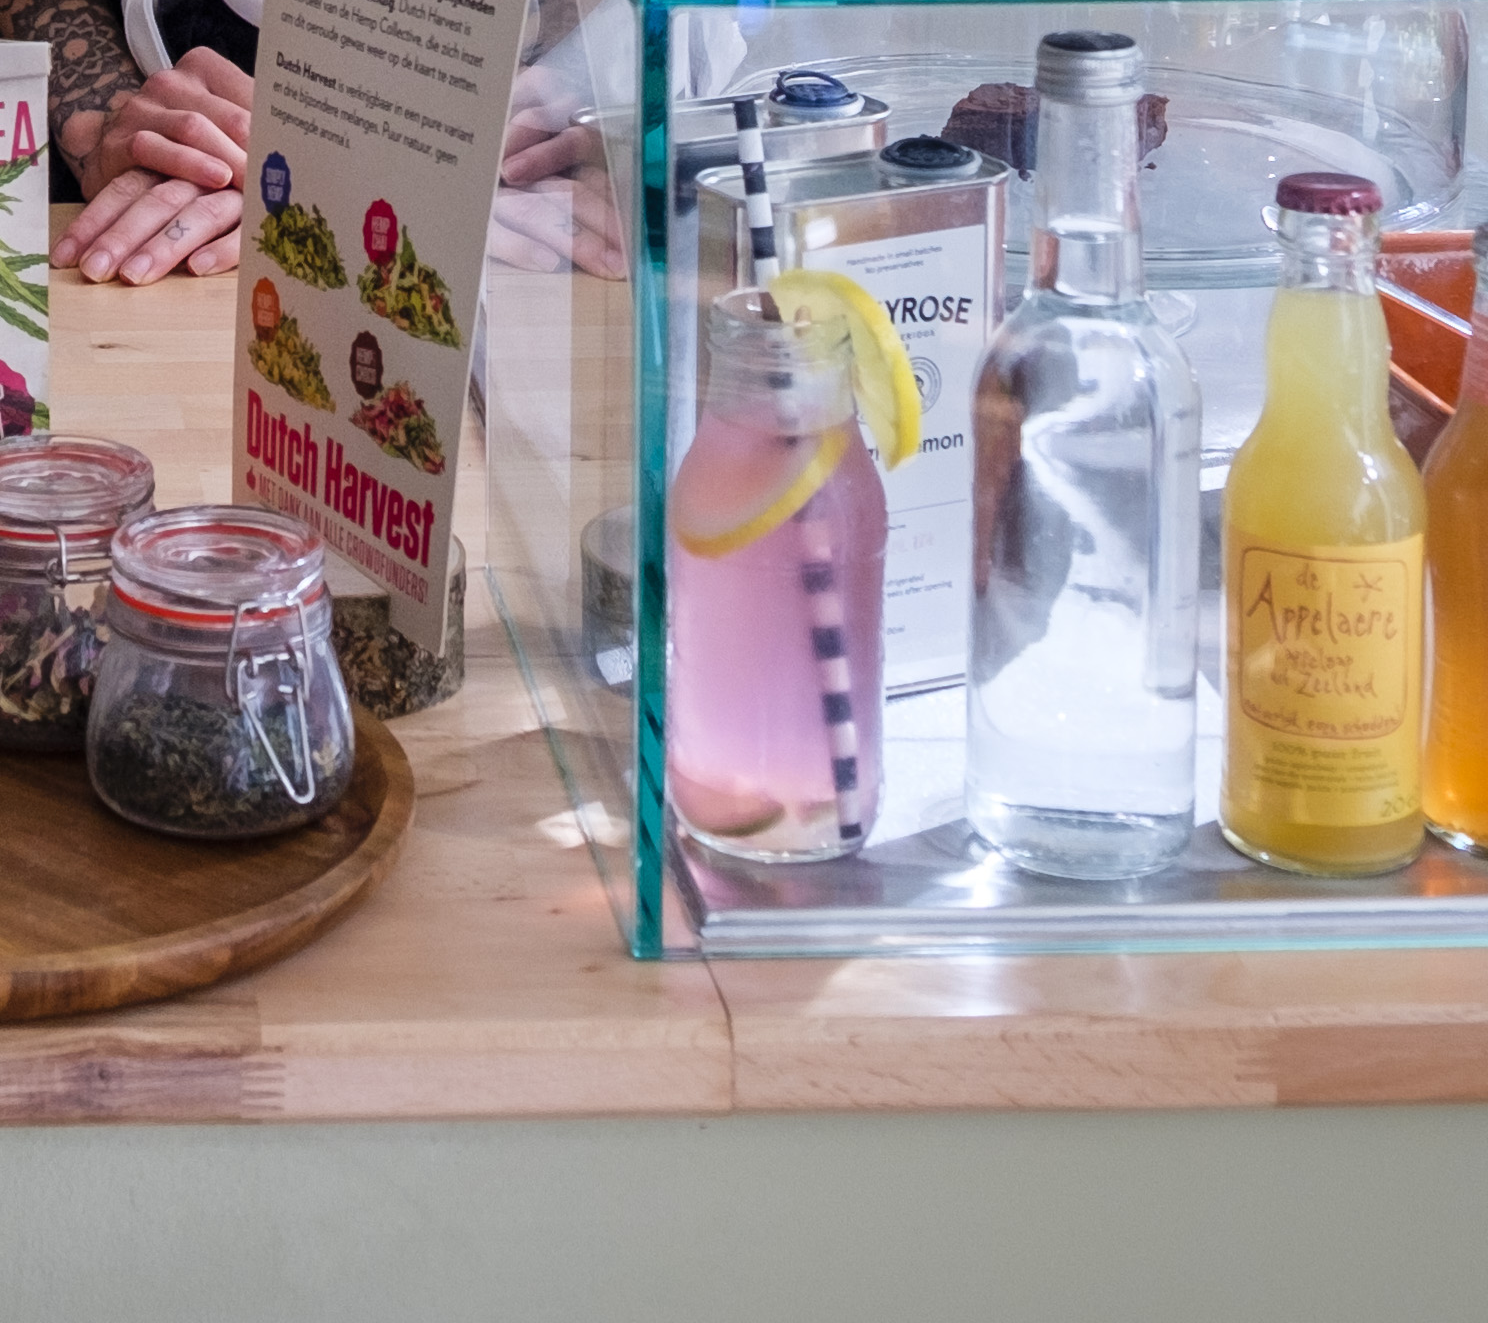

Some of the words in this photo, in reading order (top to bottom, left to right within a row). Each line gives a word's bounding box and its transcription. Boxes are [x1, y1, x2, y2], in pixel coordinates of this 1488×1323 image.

[427, 6, 463, 35] Harvest
[276, 50, 301, 75] Dutch
[303, 61, 336, 89] Harvest
[247, 388, 318, 498] Dutch
[323, 436, 435, 568] Harvest
[1295, 563, 1320, 591] de
[1245, 571, 1399, 646] Appelaere
[1295, 672, 1379, 699] Zeeland
